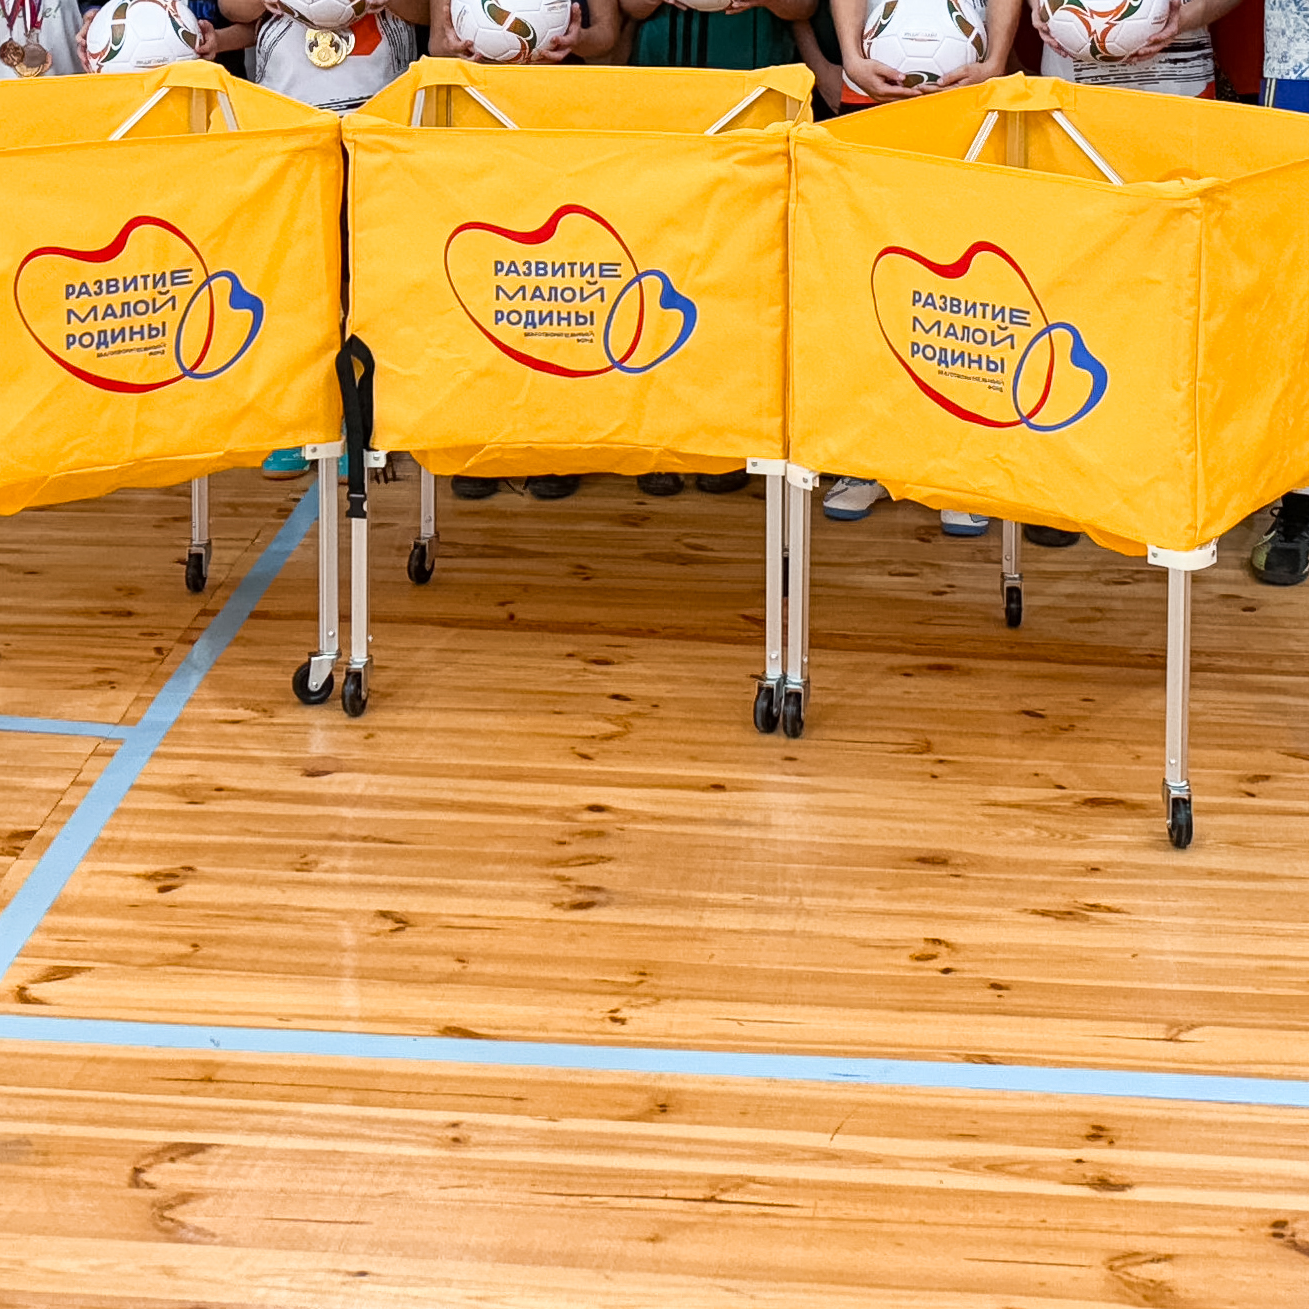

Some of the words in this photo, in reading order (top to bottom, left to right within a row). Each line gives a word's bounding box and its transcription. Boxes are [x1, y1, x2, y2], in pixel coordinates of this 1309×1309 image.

[64, 267, 194, 300] РАЗВИТИЕ
[493, 260, 622, 279] РАЗВИТИЕ
[66, 289, 177, 325] МАЛОЙ
[494, 279, 605, 304] МАЛОЙ
[494, 309, 595, 330] РОДИНЫ
[911, 290, 1032, 328] РАЗВИТИЕ
[65, 321, 167, 351] РОДИНЫ
[912, 316, 1015, 351] МАЛОЙ
[910, 341, 1005, 374] РОДИНЫ
